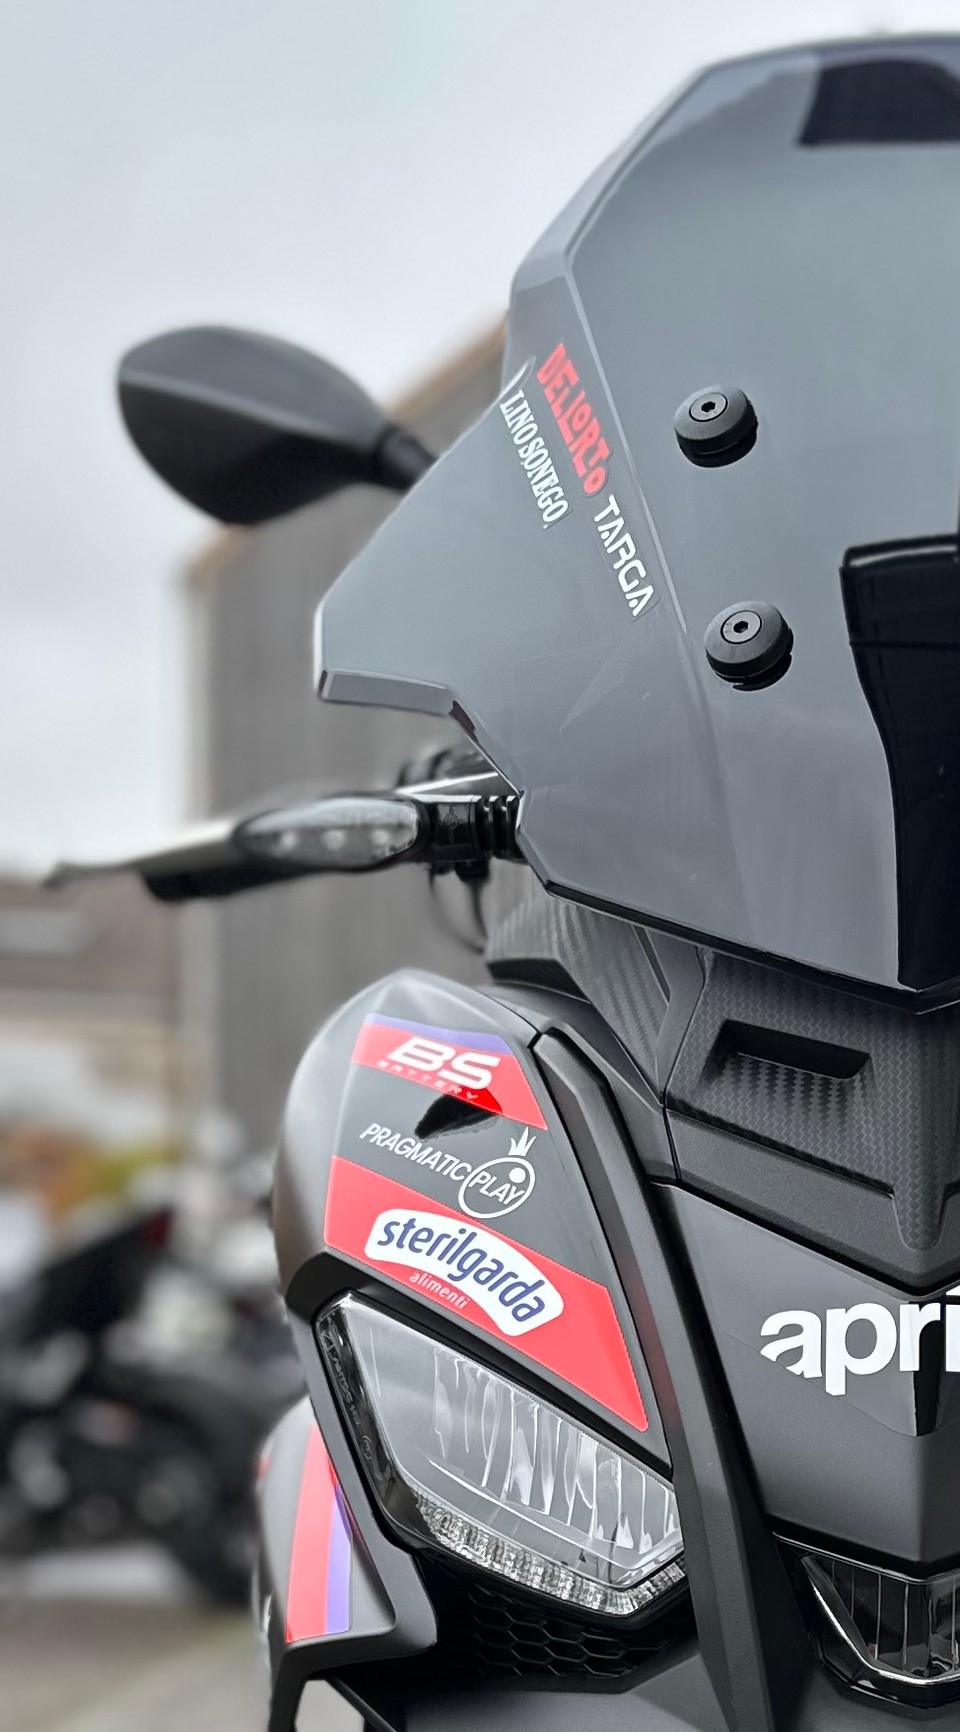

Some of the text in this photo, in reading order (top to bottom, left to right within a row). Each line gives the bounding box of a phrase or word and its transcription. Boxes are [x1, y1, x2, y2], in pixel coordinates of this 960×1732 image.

[500, 389, 570, 524] LINO SONEGO
[593, 495, 655, 617] TARGA
[386, 1036, 501, 1090] BS
[360, 1122, 525, 1205] PRAGMATIC PLAY
[376, 1217, 546, 1323] sterilgarda
[408, 1270, 471, 1310] alimenti
